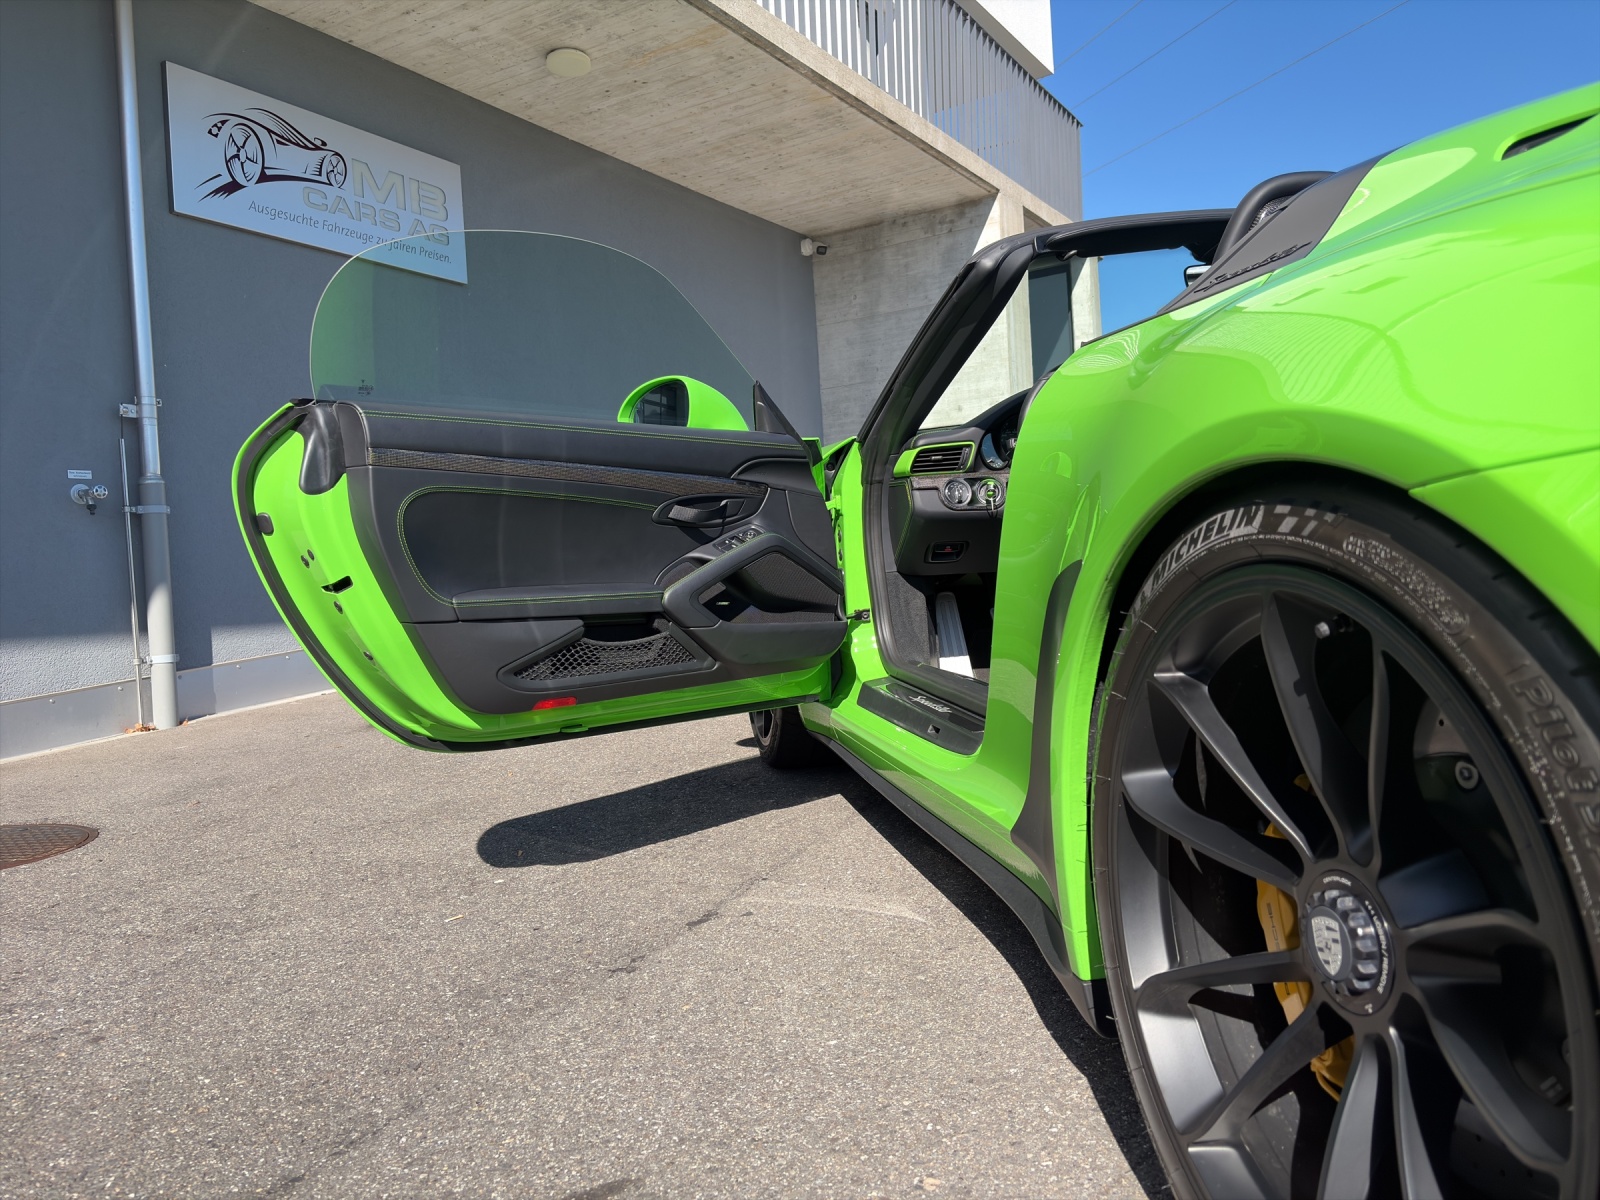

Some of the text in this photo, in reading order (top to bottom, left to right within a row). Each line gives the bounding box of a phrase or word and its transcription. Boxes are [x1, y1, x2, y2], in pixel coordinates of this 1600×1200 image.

[303, 186, 450, 246] CARS AG
[351, 158, 449, 222] MB
[248, 200, 452, 264] Ausgesuchte Fahrzeuge zu fairen Preisen.
[1151, 506, 1264, 586] MICHELIN
